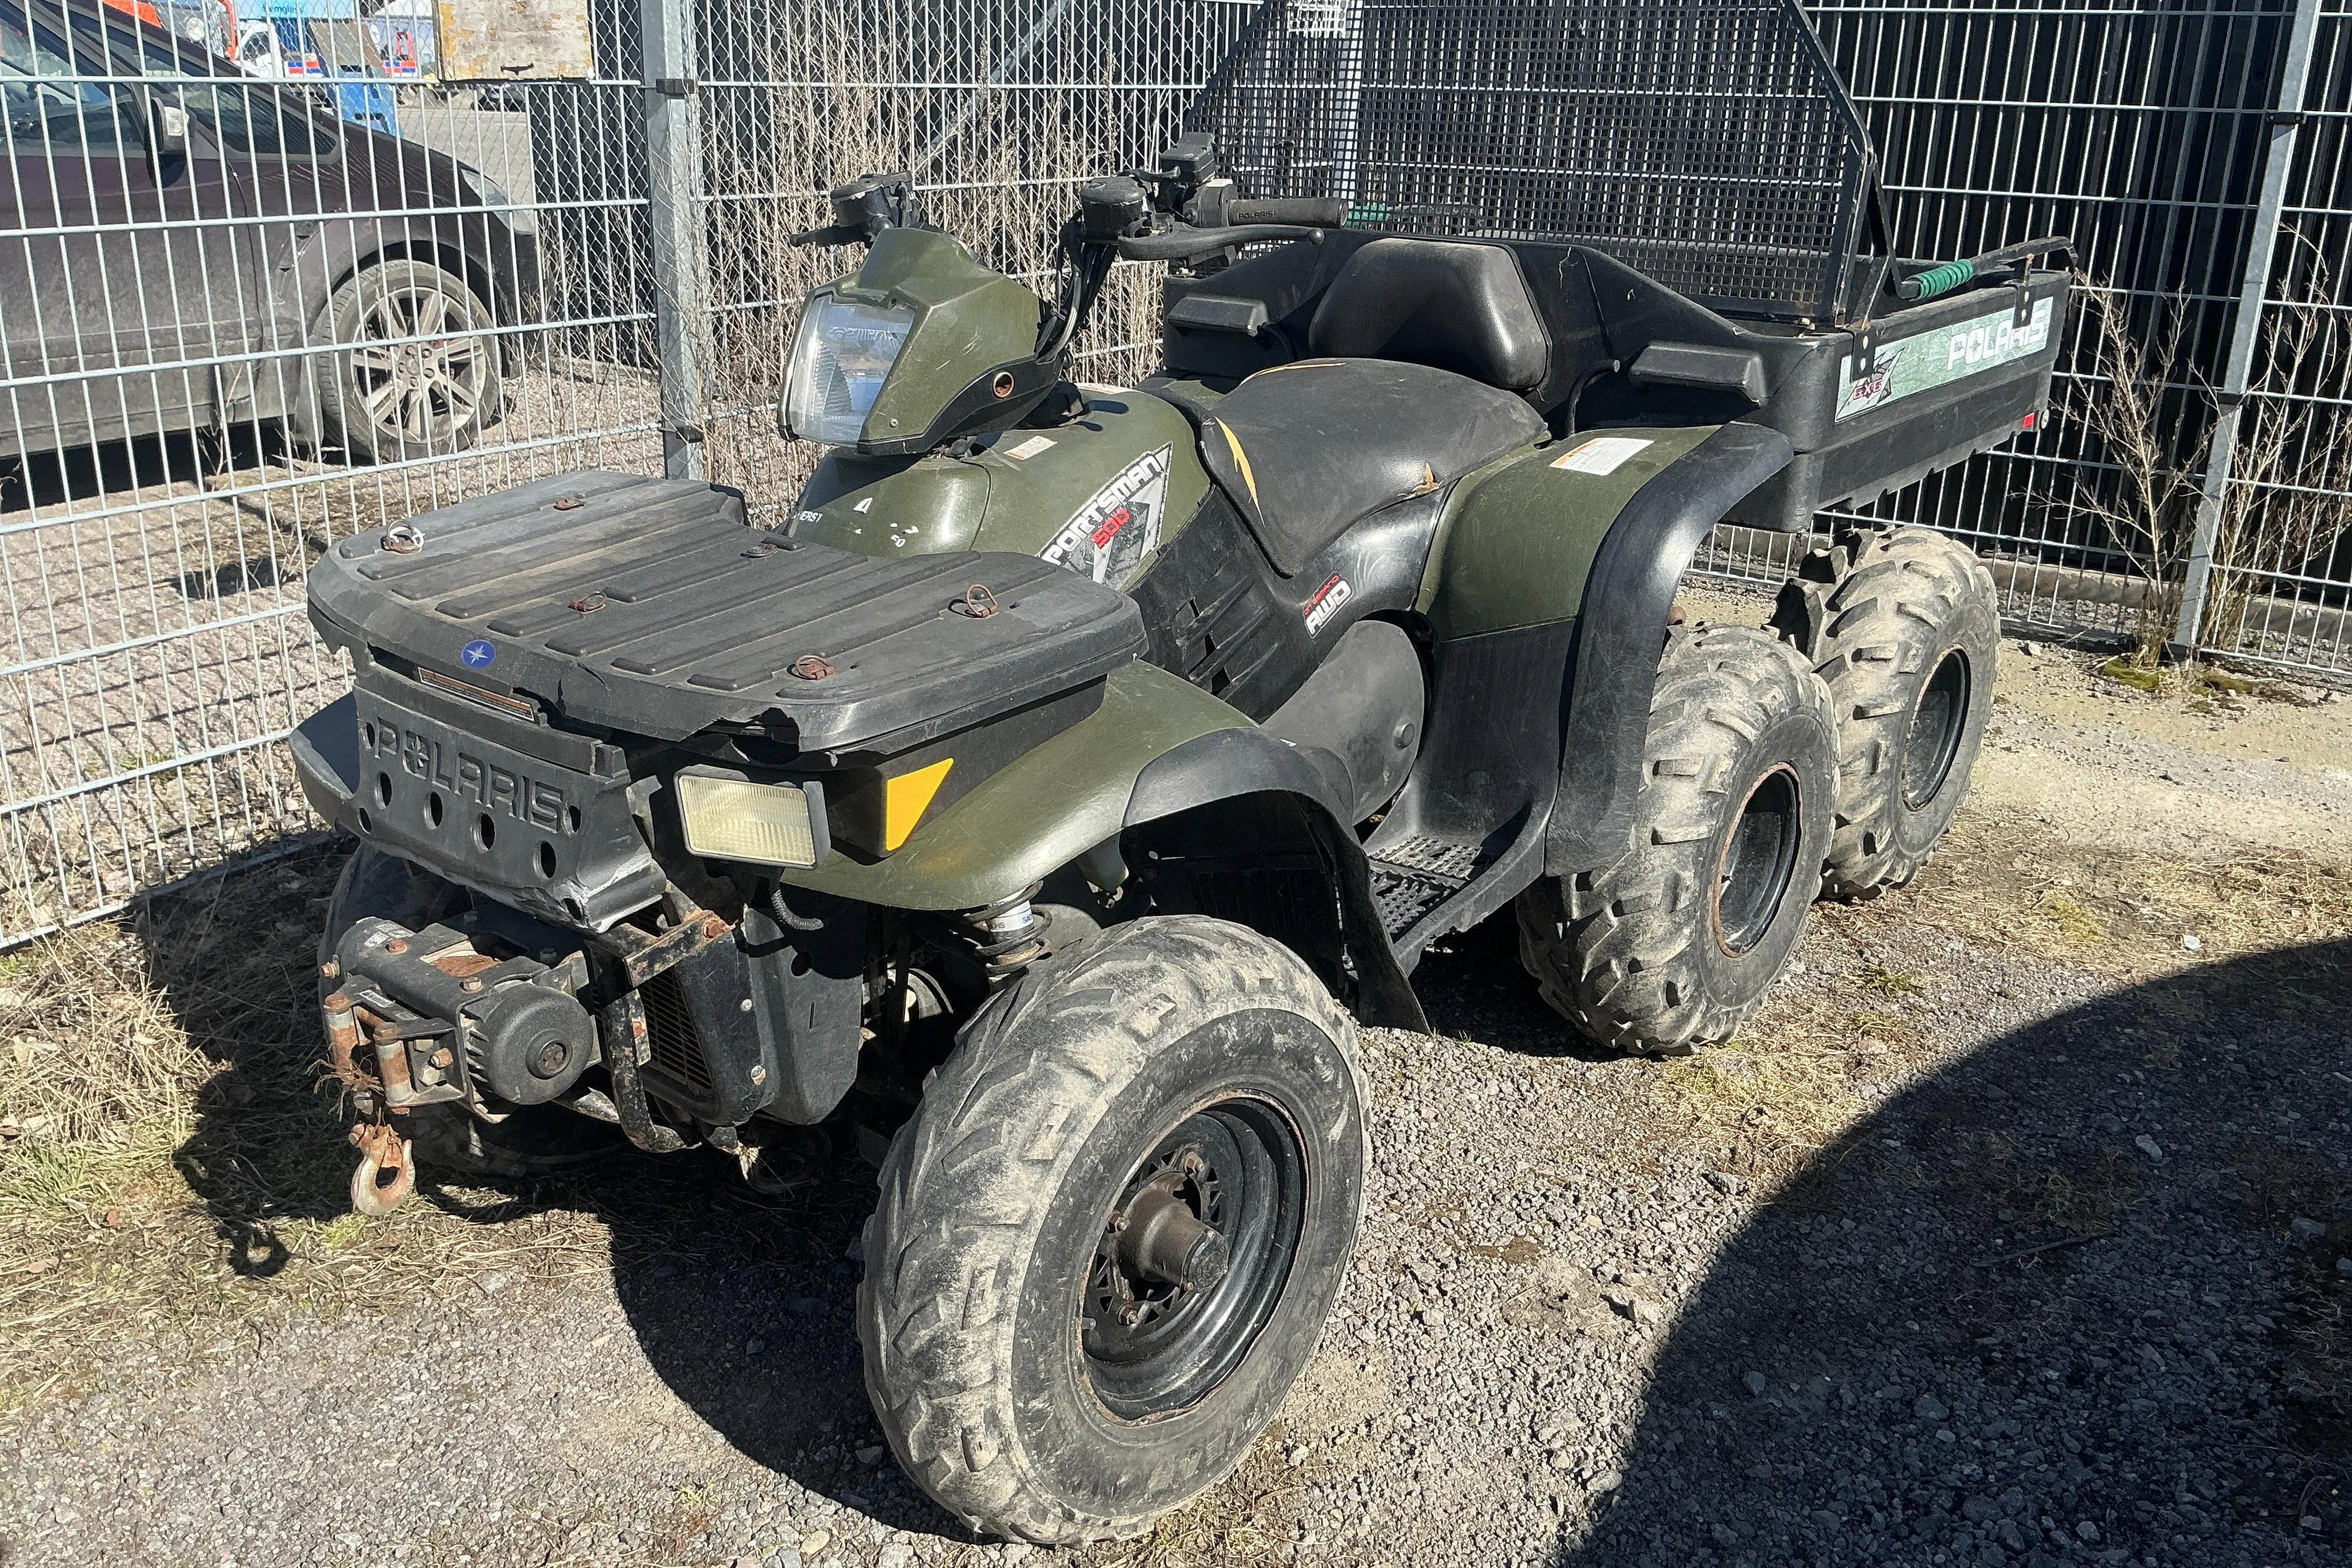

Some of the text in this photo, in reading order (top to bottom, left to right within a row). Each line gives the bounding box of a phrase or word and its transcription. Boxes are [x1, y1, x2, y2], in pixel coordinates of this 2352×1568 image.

[1238, 210, 1274, 220] POLARIS
[1947, 309, 2046, 372] POLARIS
[1041, 455, 1163, 566] PORTSMAN
[1091, 507, 1130, 550] 500
[1306, 580, 1351, 635] AWD
[374, 716, 564, 834] POLARIS
